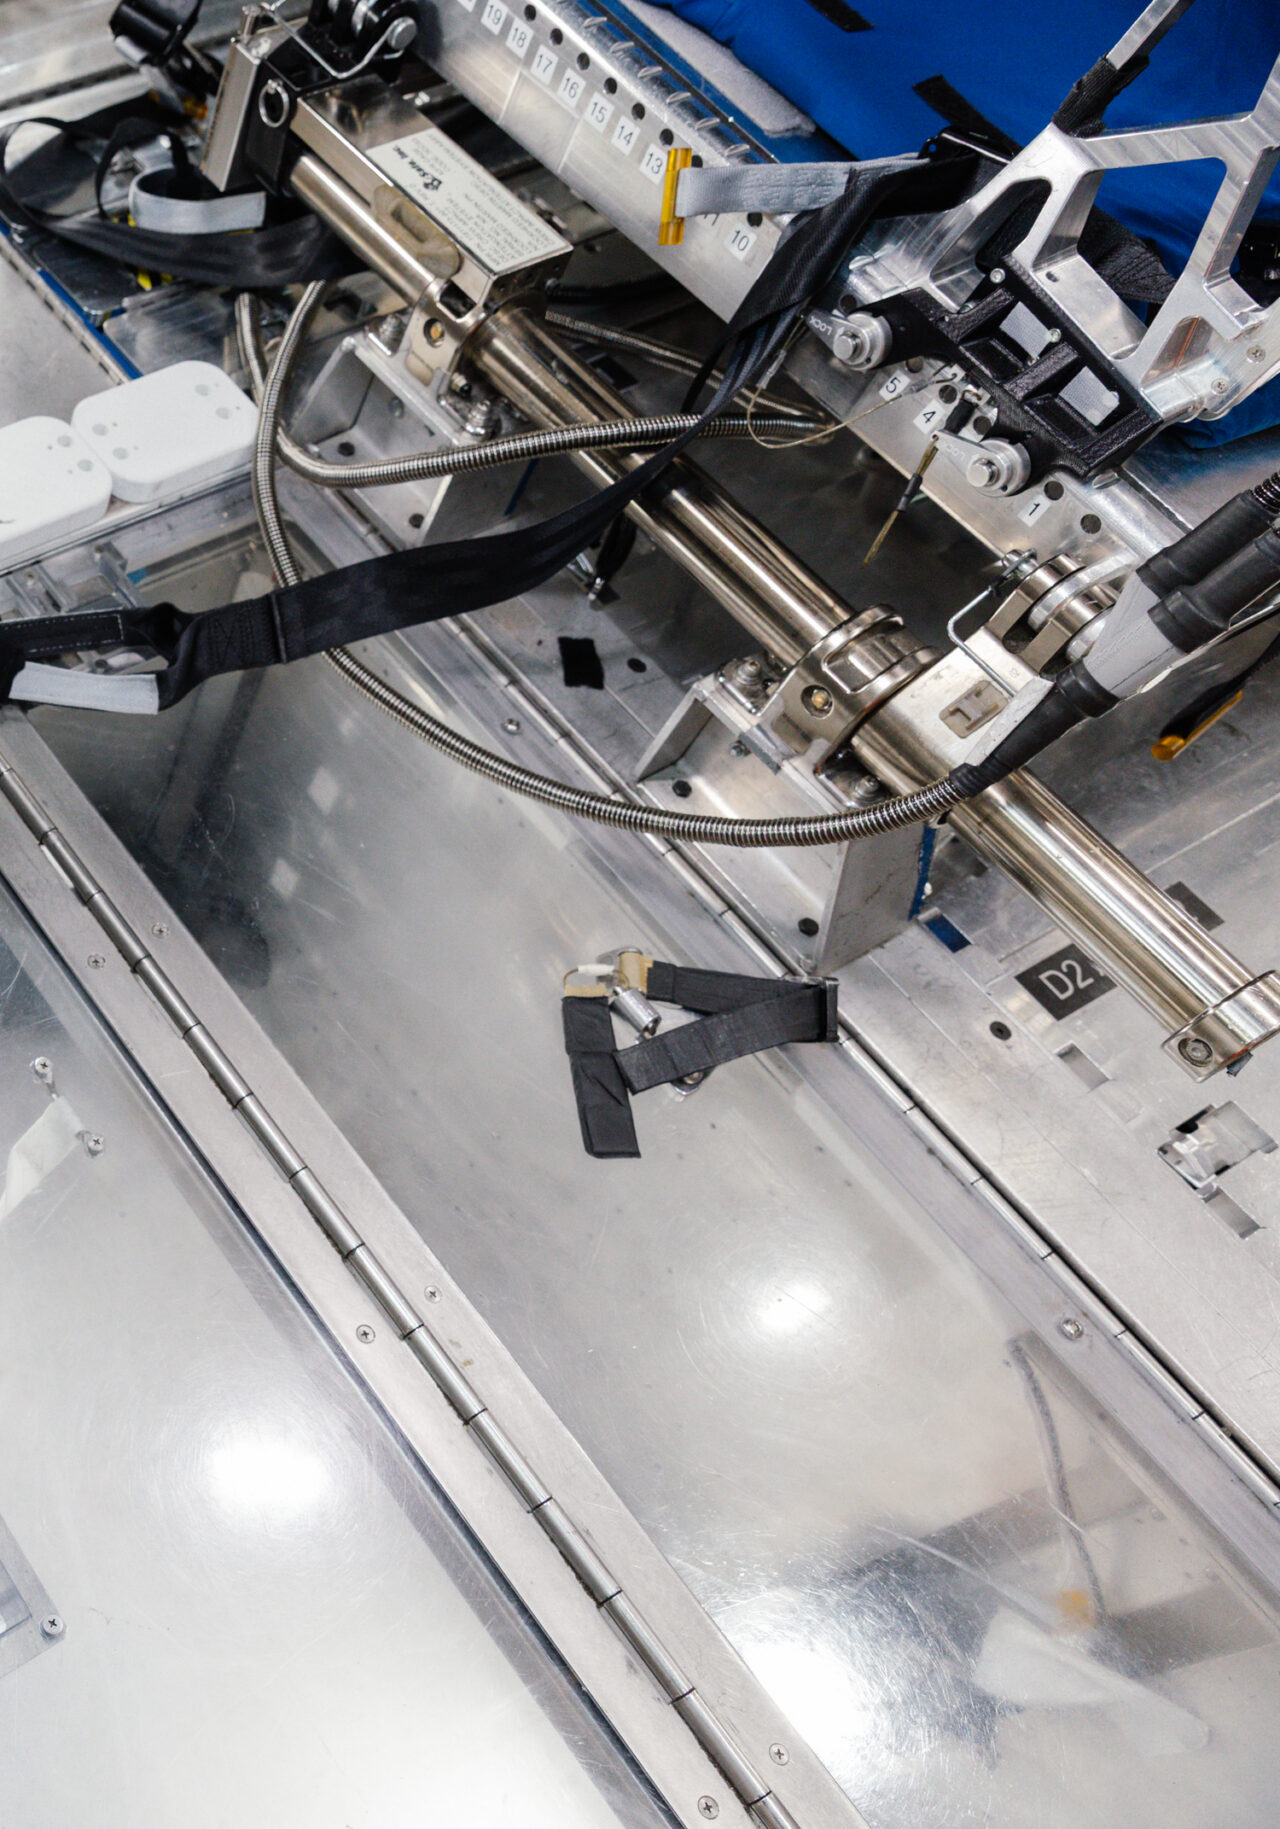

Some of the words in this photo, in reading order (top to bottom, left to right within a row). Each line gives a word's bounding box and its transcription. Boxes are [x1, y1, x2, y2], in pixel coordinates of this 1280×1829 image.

[487, 4, 503, 26] 19
[510, 27, 527, 48] 18
[536, 53, 553, 73] 17
[563, 77, 579, 99] 16
[591, 101, 608, 124] 15
[618, 124, 635, 147] 14
[645, 151, 665, 175] 13
[731, 229, 750, 252] 10
[809, 315, 833, 336] LOCK
[885, 376, 902, 395] 5
[922, 410, 937, 425] 4
[1029, 502, 1040, 517] 1
[1038, 959, 1095, 1000] D2
